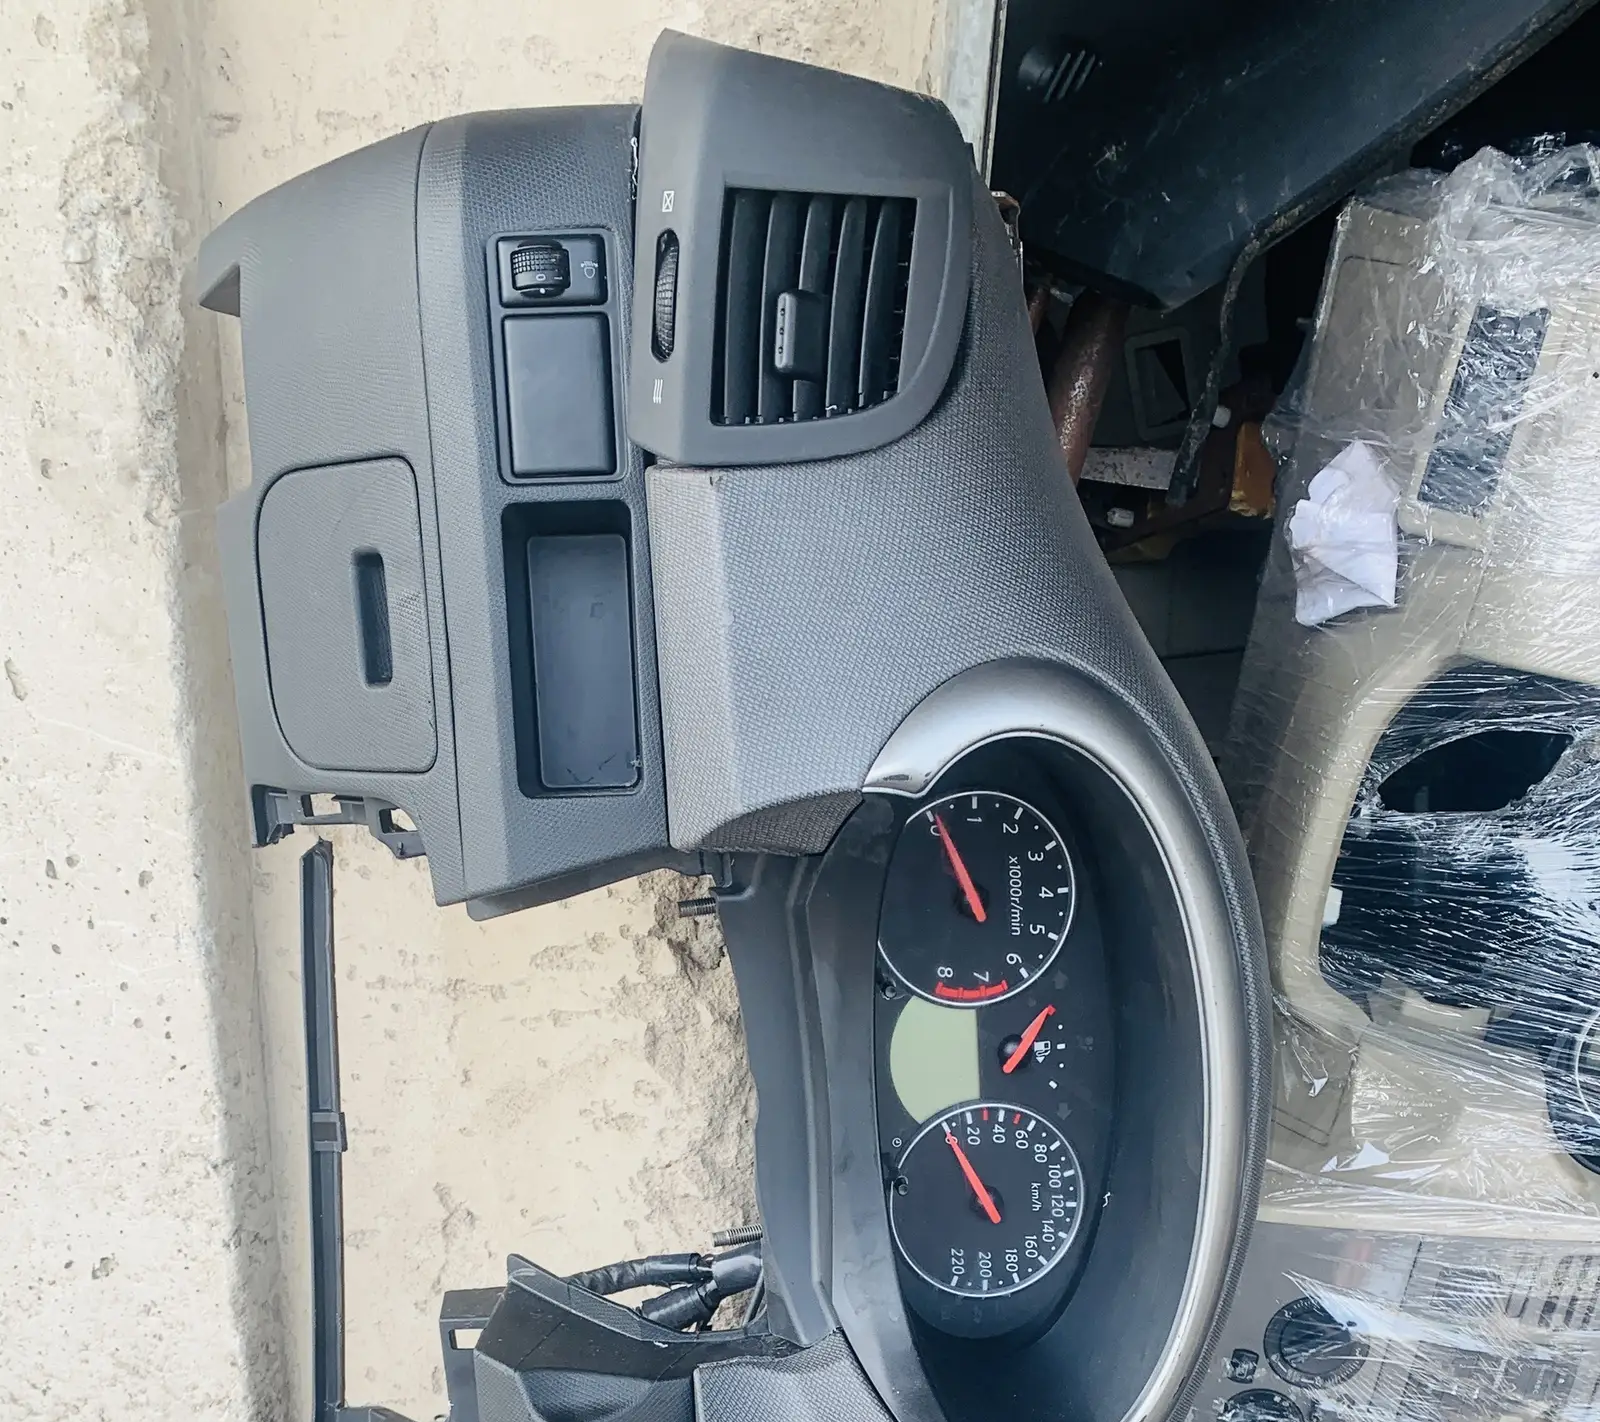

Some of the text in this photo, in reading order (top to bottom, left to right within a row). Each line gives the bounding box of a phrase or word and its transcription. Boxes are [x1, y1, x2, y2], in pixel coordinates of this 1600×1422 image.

[966, 816, 983, 824] 1
[1002, 822, 1019, 834] 2
[1028, 851, 1044, 862] 3
[1008, 855, 1024, 936] x1000r/min
[1038, 886, 1055, 899] 4
[1029, 923, 1046, 935] 5
[1006, 952, 1023, 965] 6
[937, 966, 954, 978] 8
[973, 970, 989, 983] 7
[966, 1126, 981, 1146] 20
[992, 1123, 1006, 1144] 40
[1014, 1129, 1029, 1150] 60
[1033, 1143, 1048, 1164] 80
[1048, 1163, 1062, 1189] 100
[1030, 1181, 1042, 1212] km/h
[1051, 1194, 1065, 1218] 120
[1041, 1219, 1055, 1243] 140
[1024, 1234, 1038, 1258] 160
[950, 1247, 965, 1275] 220
[978, 1251, 993, 1278] 200
[1005, 1247, 1019, 1272] 180
